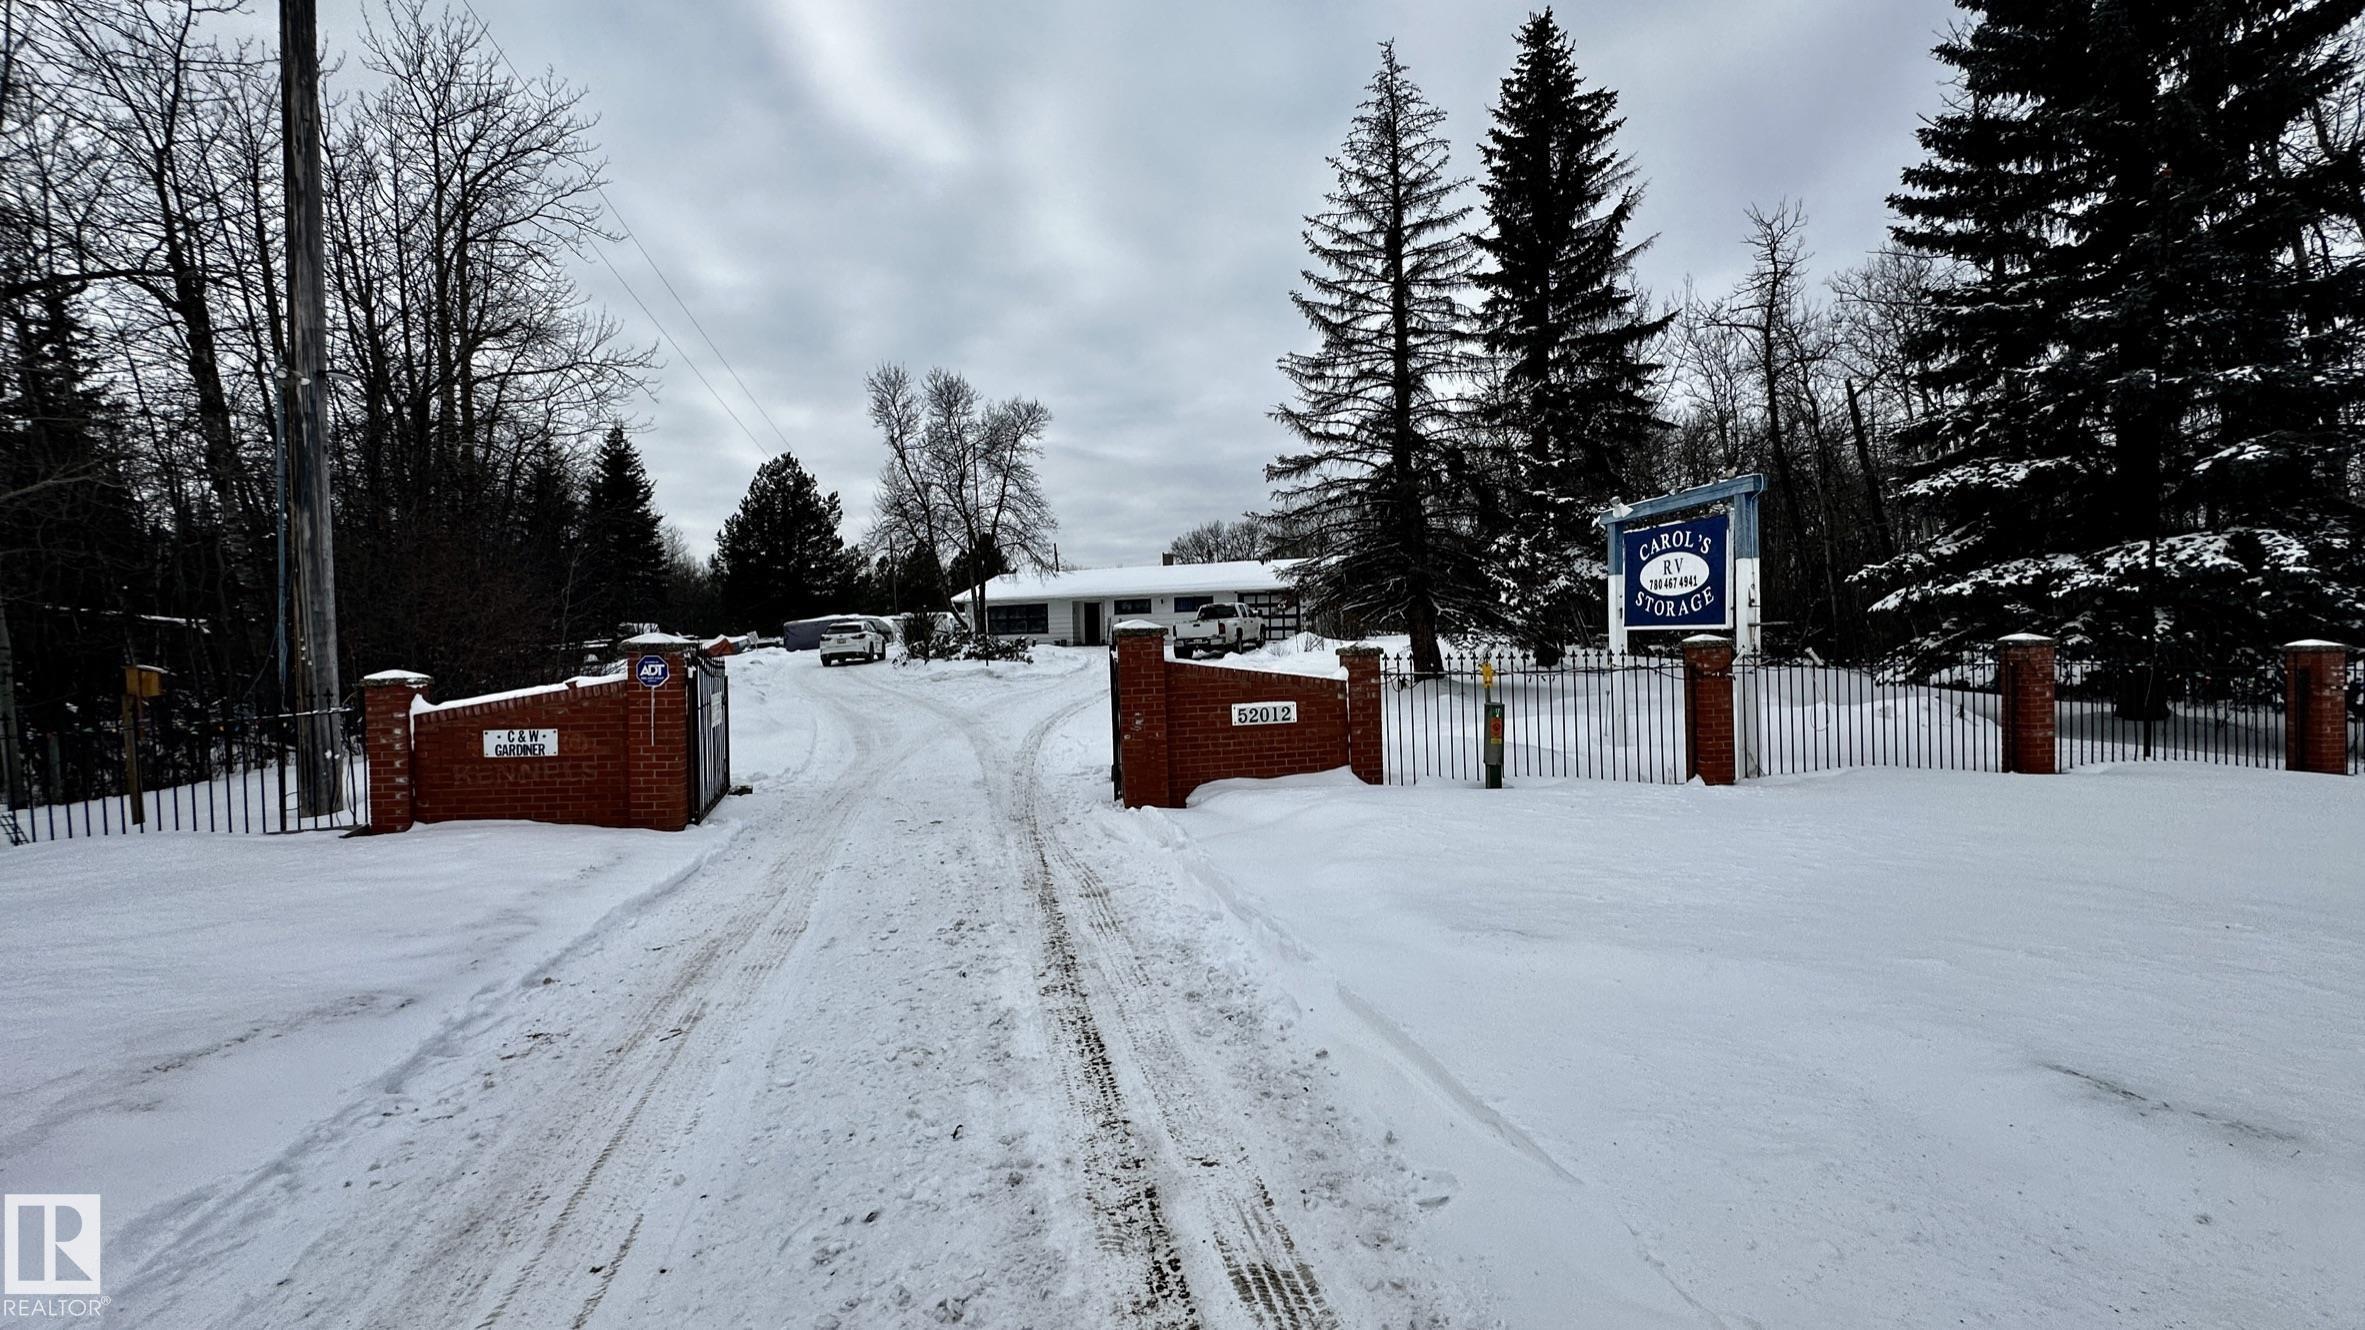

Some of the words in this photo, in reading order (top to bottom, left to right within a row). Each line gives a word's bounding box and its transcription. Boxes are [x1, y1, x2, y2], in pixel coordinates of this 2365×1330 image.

[1639, 530, 1711, 561] CAROL'S
[1663, 558, 1684, 575] RV
[1649, 579, 1663, 590] 780
[1664, 577, 1677, 589] 467
[1679, 575, 1698, 588] 4941
[1635, 586, 1715, 617] STORAGE
[640, 664, 665, 676] ADT
[1238, 706, 1291, 723] 52012
[507, 730, 515, 742] C
[518, 730, 526, 742] &
[529, 730, 539, 742] W
[495, 743, 546, 756] GARDINER
